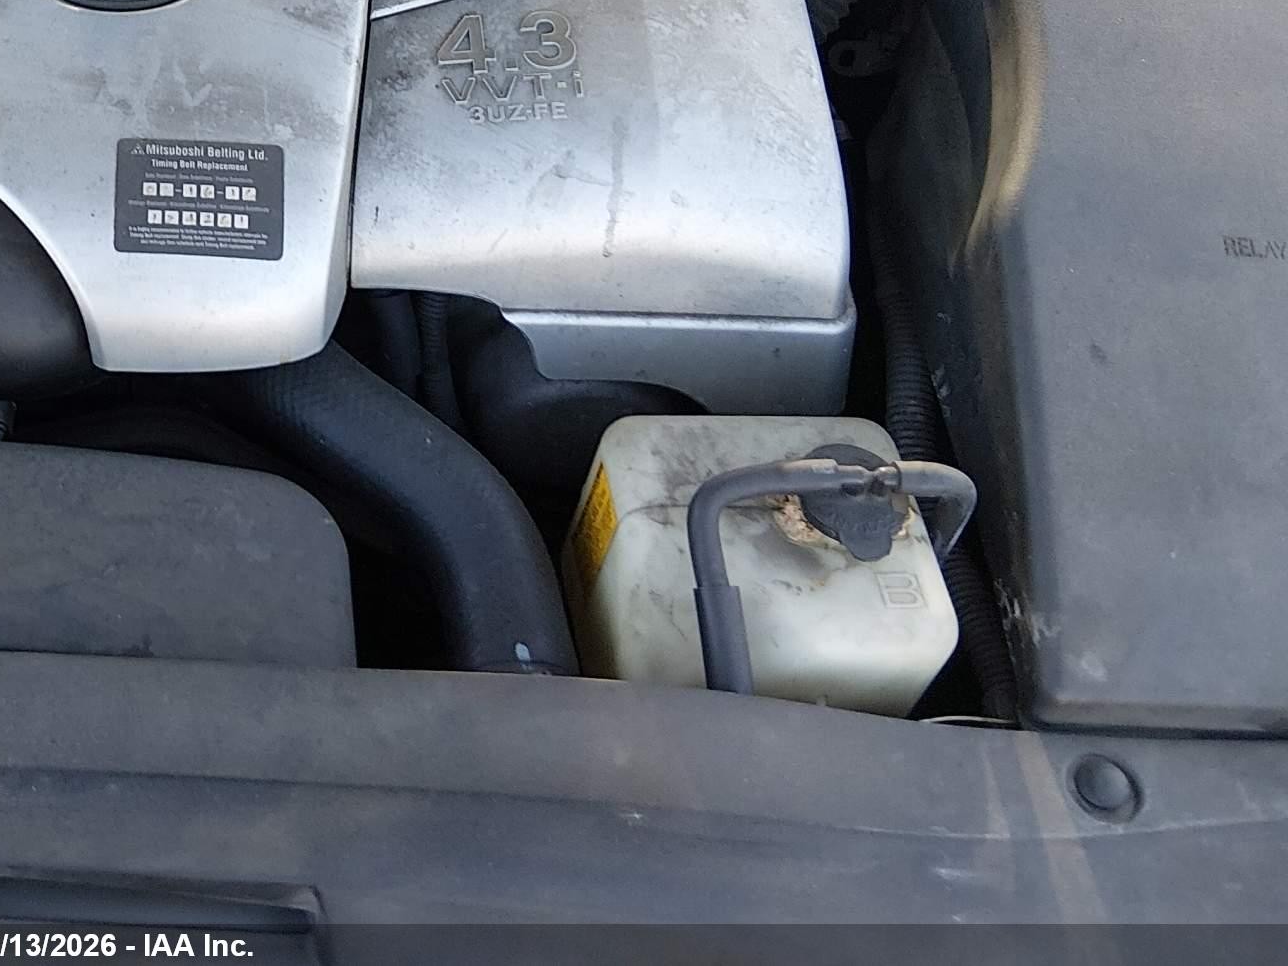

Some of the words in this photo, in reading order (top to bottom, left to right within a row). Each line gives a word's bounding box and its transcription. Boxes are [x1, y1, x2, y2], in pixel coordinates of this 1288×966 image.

[437, 10, 578, 73] 4.3
[441, 70, 585, 105] VVT-i
[468, 101, 569, 124] 3UZ-FE
[145, 143, 205, 158] Mitsuboshi
[207, 146, 245, 161] Belting
[247, 148, 269, 161] Ltd.
[151, 158, 178, 171] Timing
[179, 159, 196, 170] Belt
[197, 160, 249, 172] Replacement
[1222, 235, 1288, 260] RELAY
